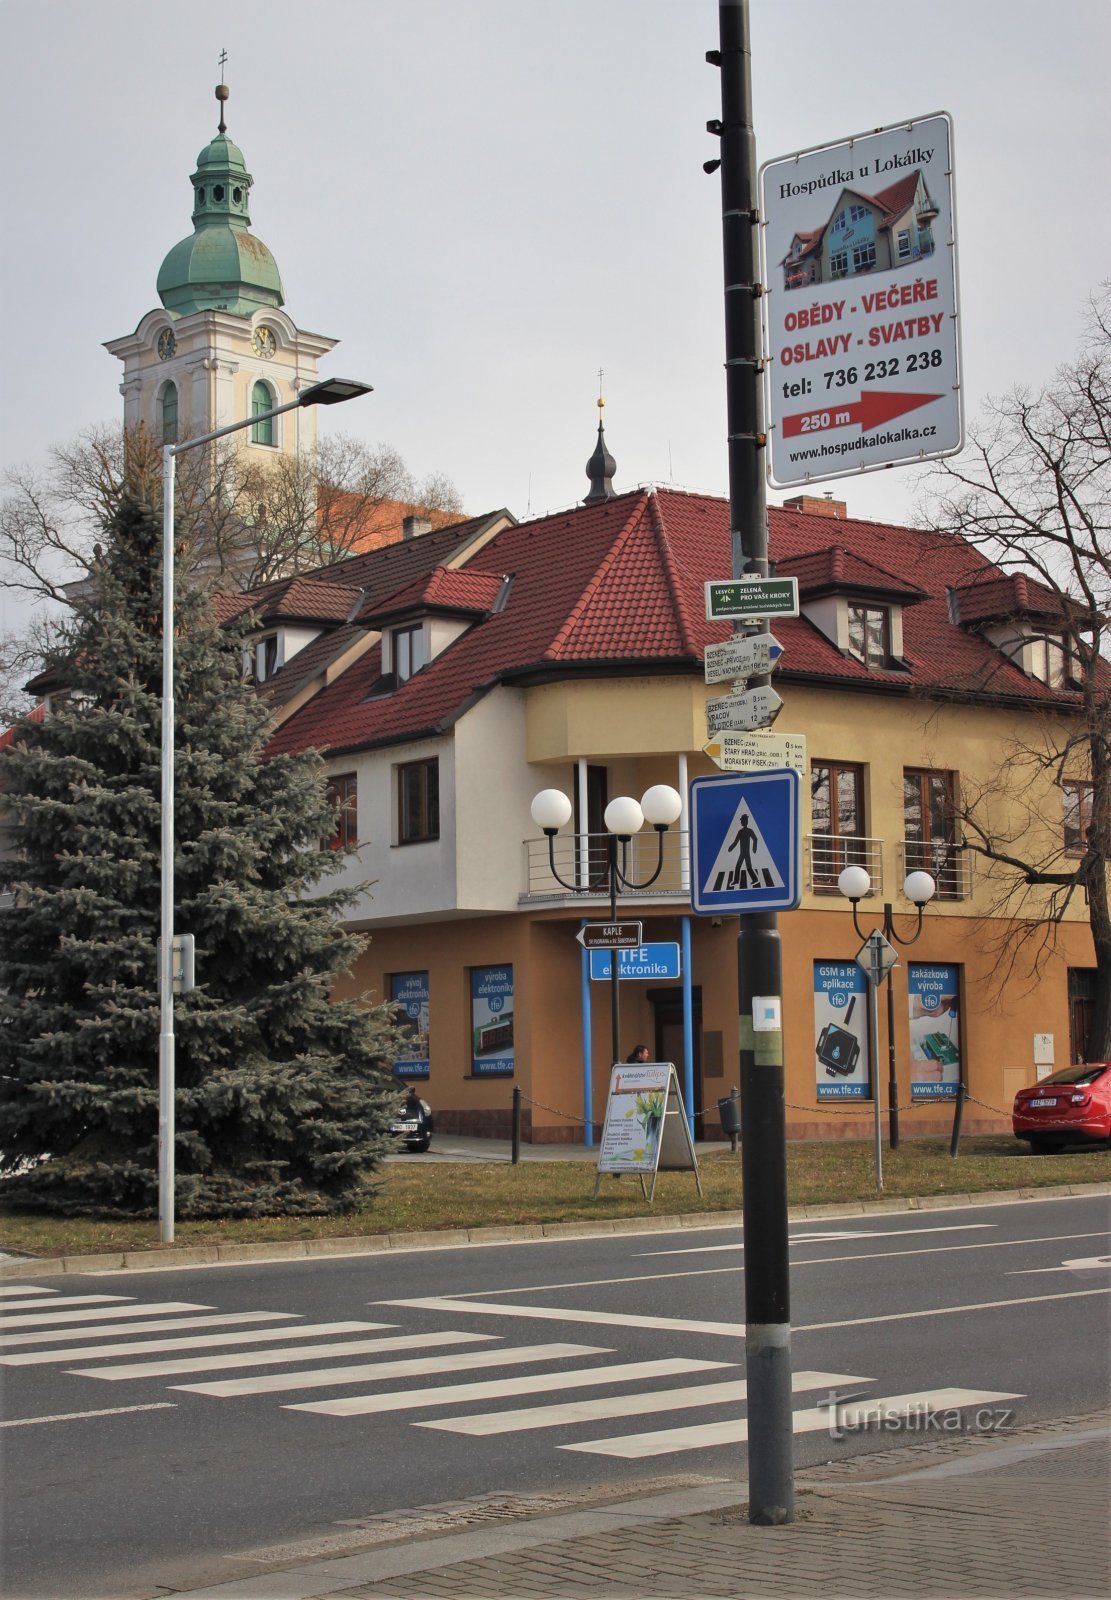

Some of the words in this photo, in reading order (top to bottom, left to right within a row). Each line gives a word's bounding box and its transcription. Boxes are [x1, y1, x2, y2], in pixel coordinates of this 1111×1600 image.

[779, 169, 854, 199] Hospůdka
[859, 166, 869, 178] u
[874, 148, 935, 173] Lokálky
[784, 300, 846, 332] OBĚDY
[861, 277, 938, 314] VEČEŘE
[780, 333, 852, 366] OSLAVY
[868, 312, 944, 347] SVATBY
[782, 378, 812, 398] tel:
[823, 366, 858, 389] 736
[864, 358, 899, 381] 232
[906, 349, 942, 373] 238
[800, 412, 831, 432] 250
[835, 412, 850, 424] m
[789, 426, 937, 462] www.hospudkalokalka.cz
[740, 586, 762, 594] ZELENÁ
[708, 701, 728, 712] BZENEC
[751, 715, 757, 723] 12
[724, 738, 744, 746] BZENEC
[741, 749, 756, 757] HRAD
[603, 926, 622, 936] KAPLE
[618, 948, 648, 962] TFE
[602, 963, 668, 975] elktronika
[819, 967, 838, 977] GSM
[840, 969, 845, 977] a
[846, 967, 857, 977] RF
[912, 969, 949, 980] zakázková
[485, 971, 507, 982] výroba
[406, 977, 422, 989] vývoj
[822, 979, 855, 990] aplikace
[917, 981, 944, 992] výroba
[478, 984, 513, 995] elektroniky
[819, 1084, 862, 1095] www.tfe.cz
[913, 1084, 953, 1094] www.tfe.cz
